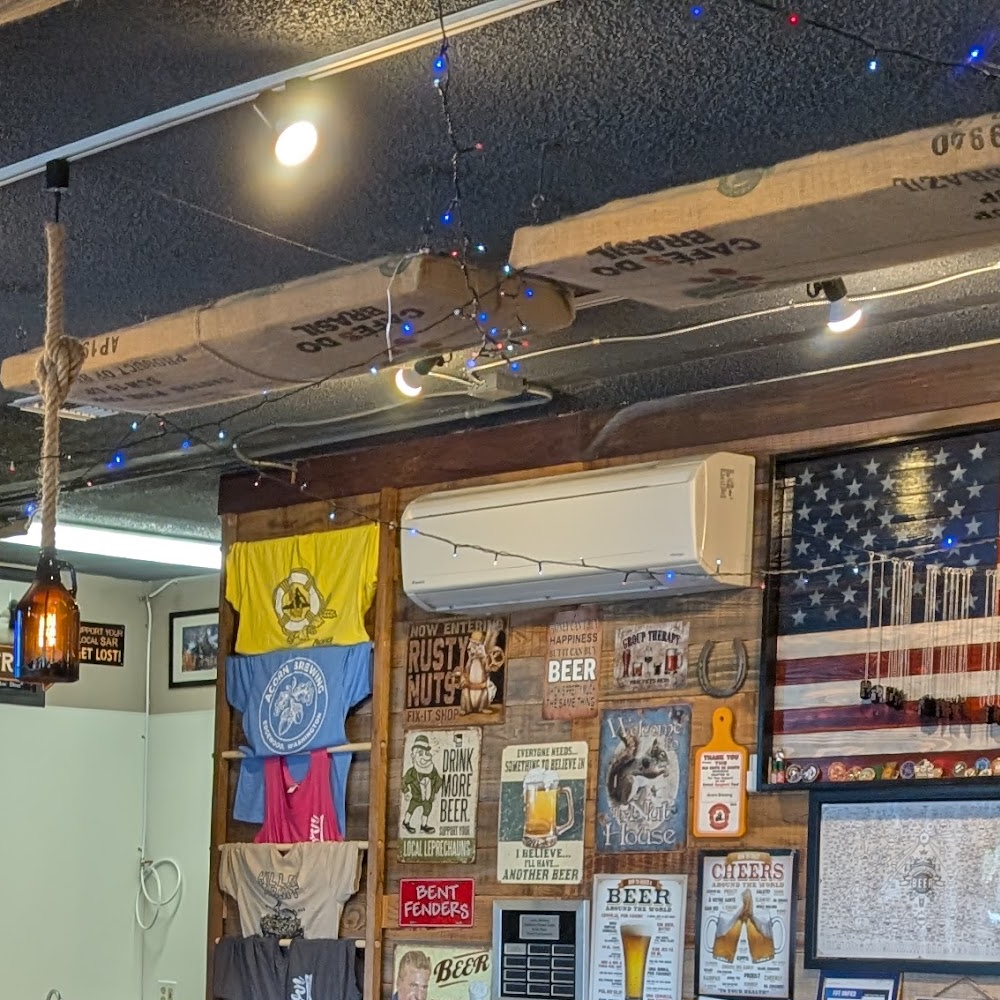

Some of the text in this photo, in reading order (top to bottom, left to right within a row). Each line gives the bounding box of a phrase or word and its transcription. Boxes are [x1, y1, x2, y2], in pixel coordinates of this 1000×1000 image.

[587, 229, 716, 259] BRASIL
[591, 259, 647, 276] DO
[291, 306, 386, 337] BRASIL
[296, 337, 343, 353] DO
[105, 628, 124, 637] YOUR
[410, 623, 438, 638] NOW
[549, 633, 598, 645] HAPPINESS
[100, 637, 119, 648] SAR
[623, 630, 680, 649] GROUP THERAPY
[95, 648, 122, 663] LOST!
[408, 636, 470, 673] RUSTY
[548, 658, 597, 682] BEER
[265, 661, 325, 703] ACORN BREWING
[408, 671, 456, 707] NUTS
[407, 708, 460, 722] FIX-IT SHOP
[287, 712, 322, 750] WASHINGTON
[607, 717, 683, 739] Welcome
[442, 748, 474, 773] DRINK
[517, 747, 550, 758] EVERYONE
[504, 759, 540, 772] SOMETHING
[550, 758, 577, 771] BELIEVE
[578, 758, 585, 769] IN
[441, 773, 472, 797] MORE
[440, 798, 471, 822] BEER.
[603, 823, 676, 846] House
[403, 840, 423, 857] LOCAL
[516, 849, 520, 858] I
[502, 869, 579, 880] ANOTHER BEER
[711, 863, 784, 880] CHEERS
[416, 884, 459, 900] BENT
[606, 888, 671, 904] BEER
[404, 901, 469, 919] FENDERS
[434, 954, 490, 983] BEER
